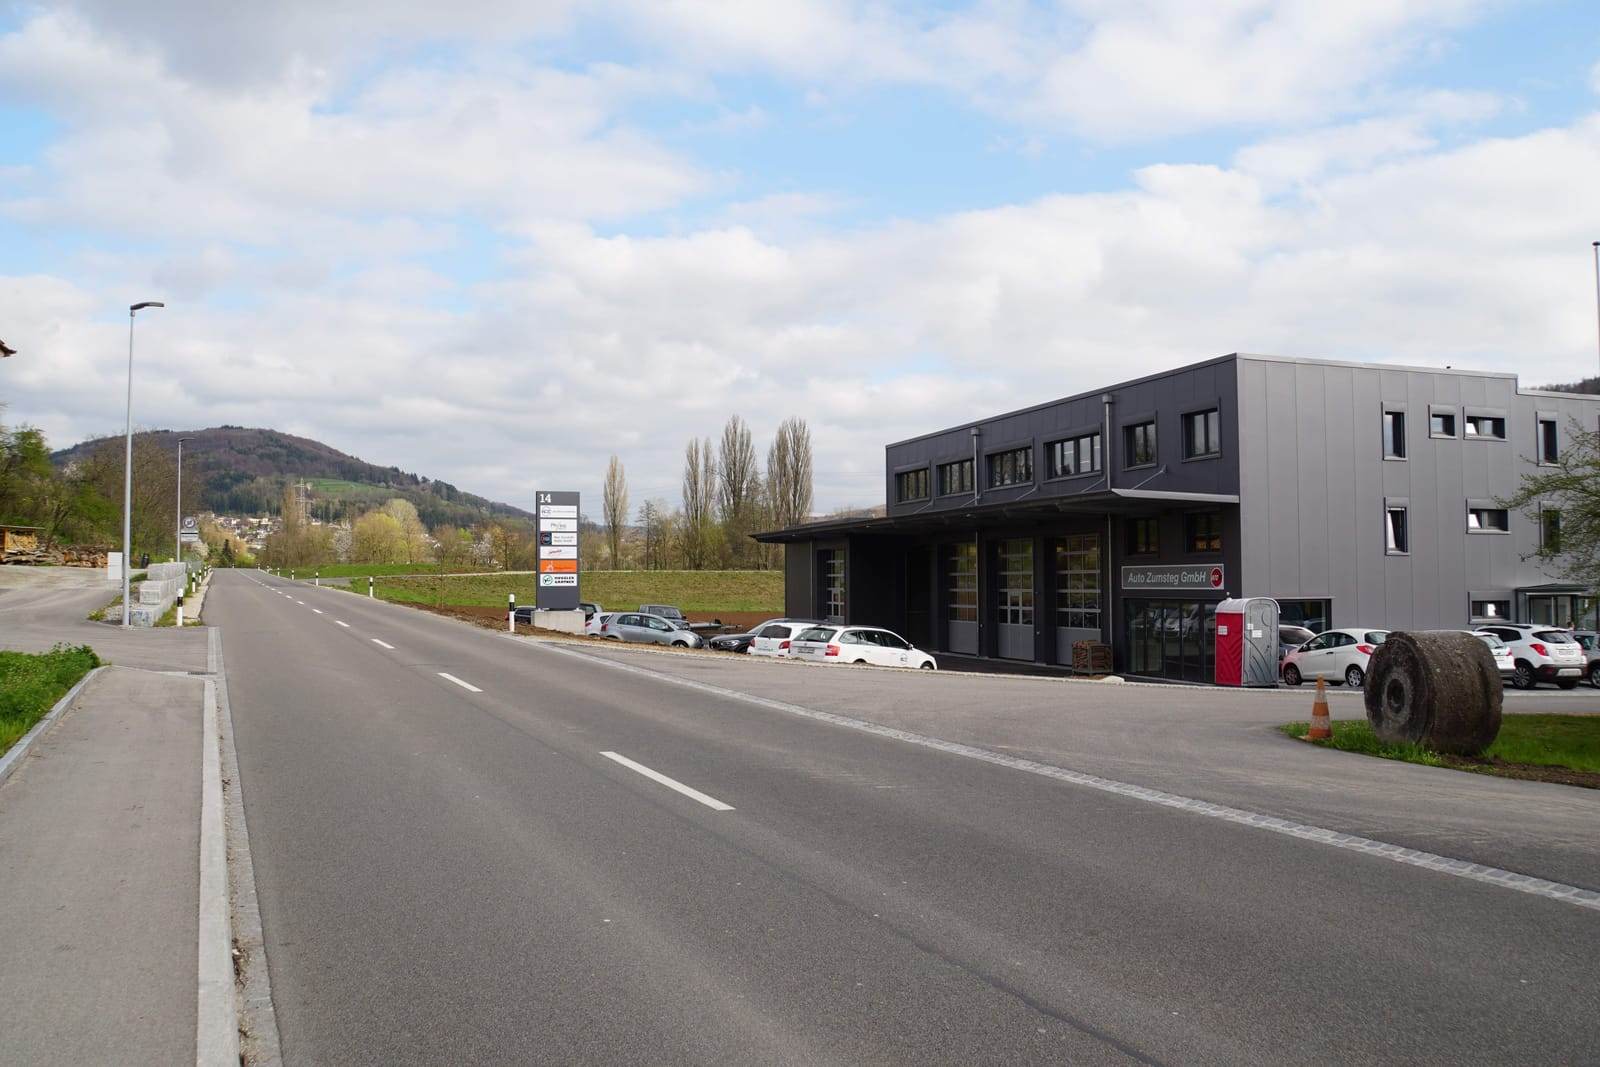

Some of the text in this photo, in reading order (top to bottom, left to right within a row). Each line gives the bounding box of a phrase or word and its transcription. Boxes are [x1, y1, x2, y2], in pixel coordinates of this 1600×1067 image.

[540, 493, 551, 503] 14
[1128, 572, 1145, 583] Auto
[1146, 571, 1178, 585] Zumsteg
[1181, 571, 1206, 583] GmbH
